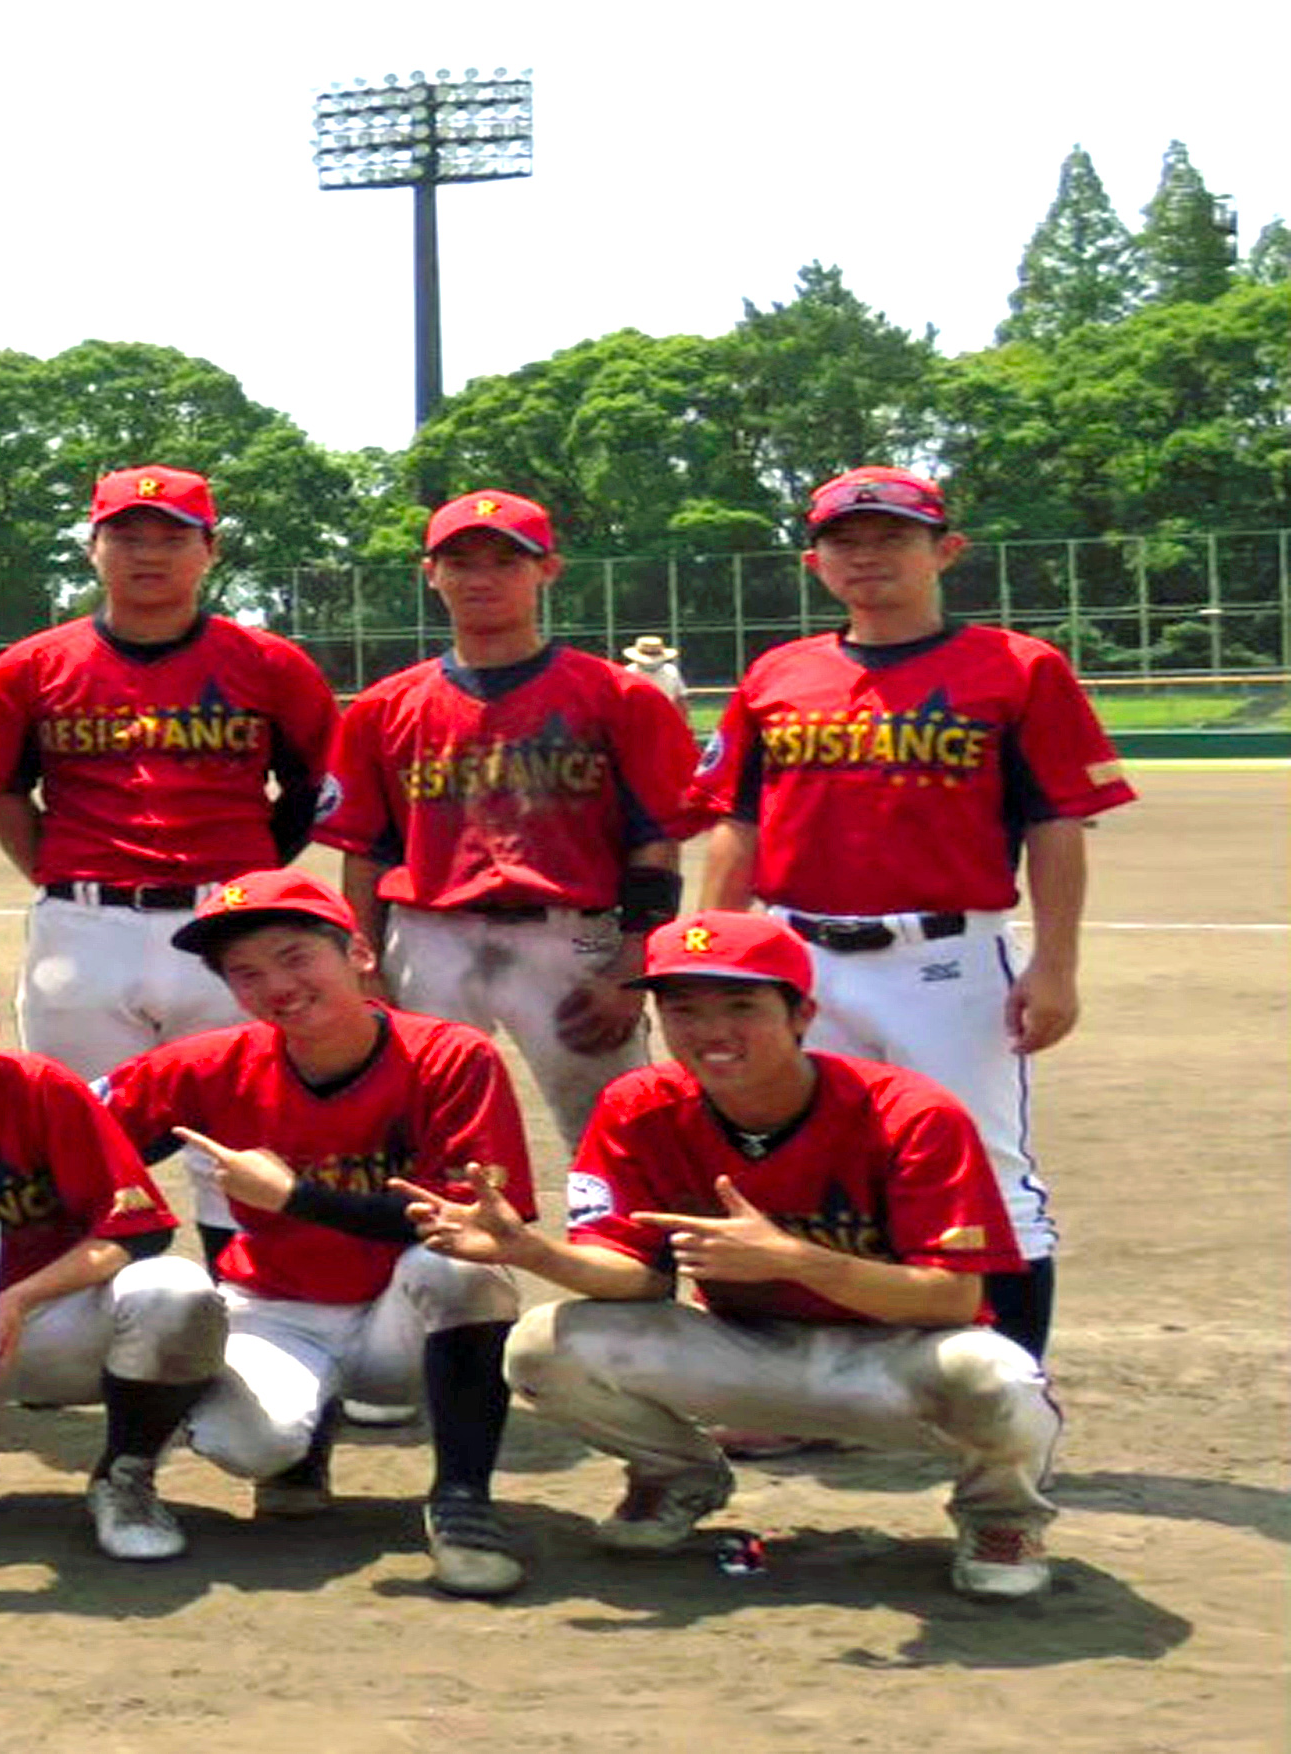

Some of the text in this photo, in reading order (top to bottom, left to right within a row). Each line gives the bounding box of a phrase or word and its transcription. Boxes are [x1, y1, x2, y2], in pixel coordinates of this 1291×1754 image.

[137, 476, 158, 497] R
[474, 497, 496, 518] R
[685, 926, 710, 951] R
